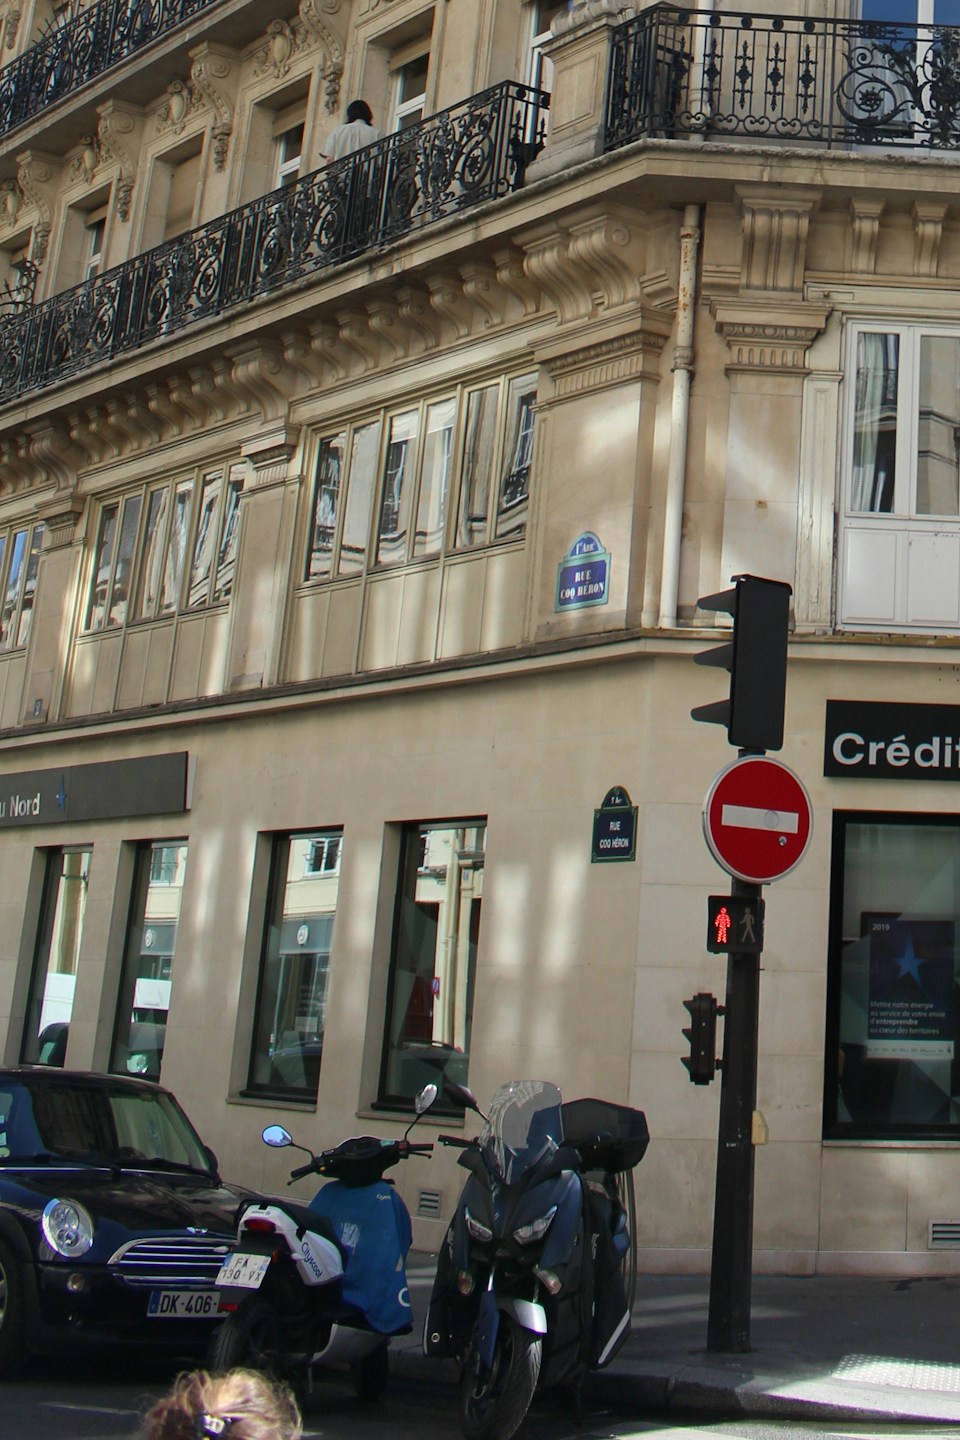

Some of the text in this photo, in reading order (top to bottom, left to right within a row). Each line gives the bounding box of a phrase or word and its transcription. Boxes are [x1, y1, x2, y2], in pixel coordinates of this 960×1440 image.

[575, 569, 592, 582] RUE
[560, 581, 604, 599] COQ HÉRON
[9, 792, 41, 817] Nord
[609, 821, 621, 831] RUE
[599, 837, 629, 849] COQ HÉRON
[872, 923, 890, 931] 2019
[234, 1257, 249, 1268] FA
